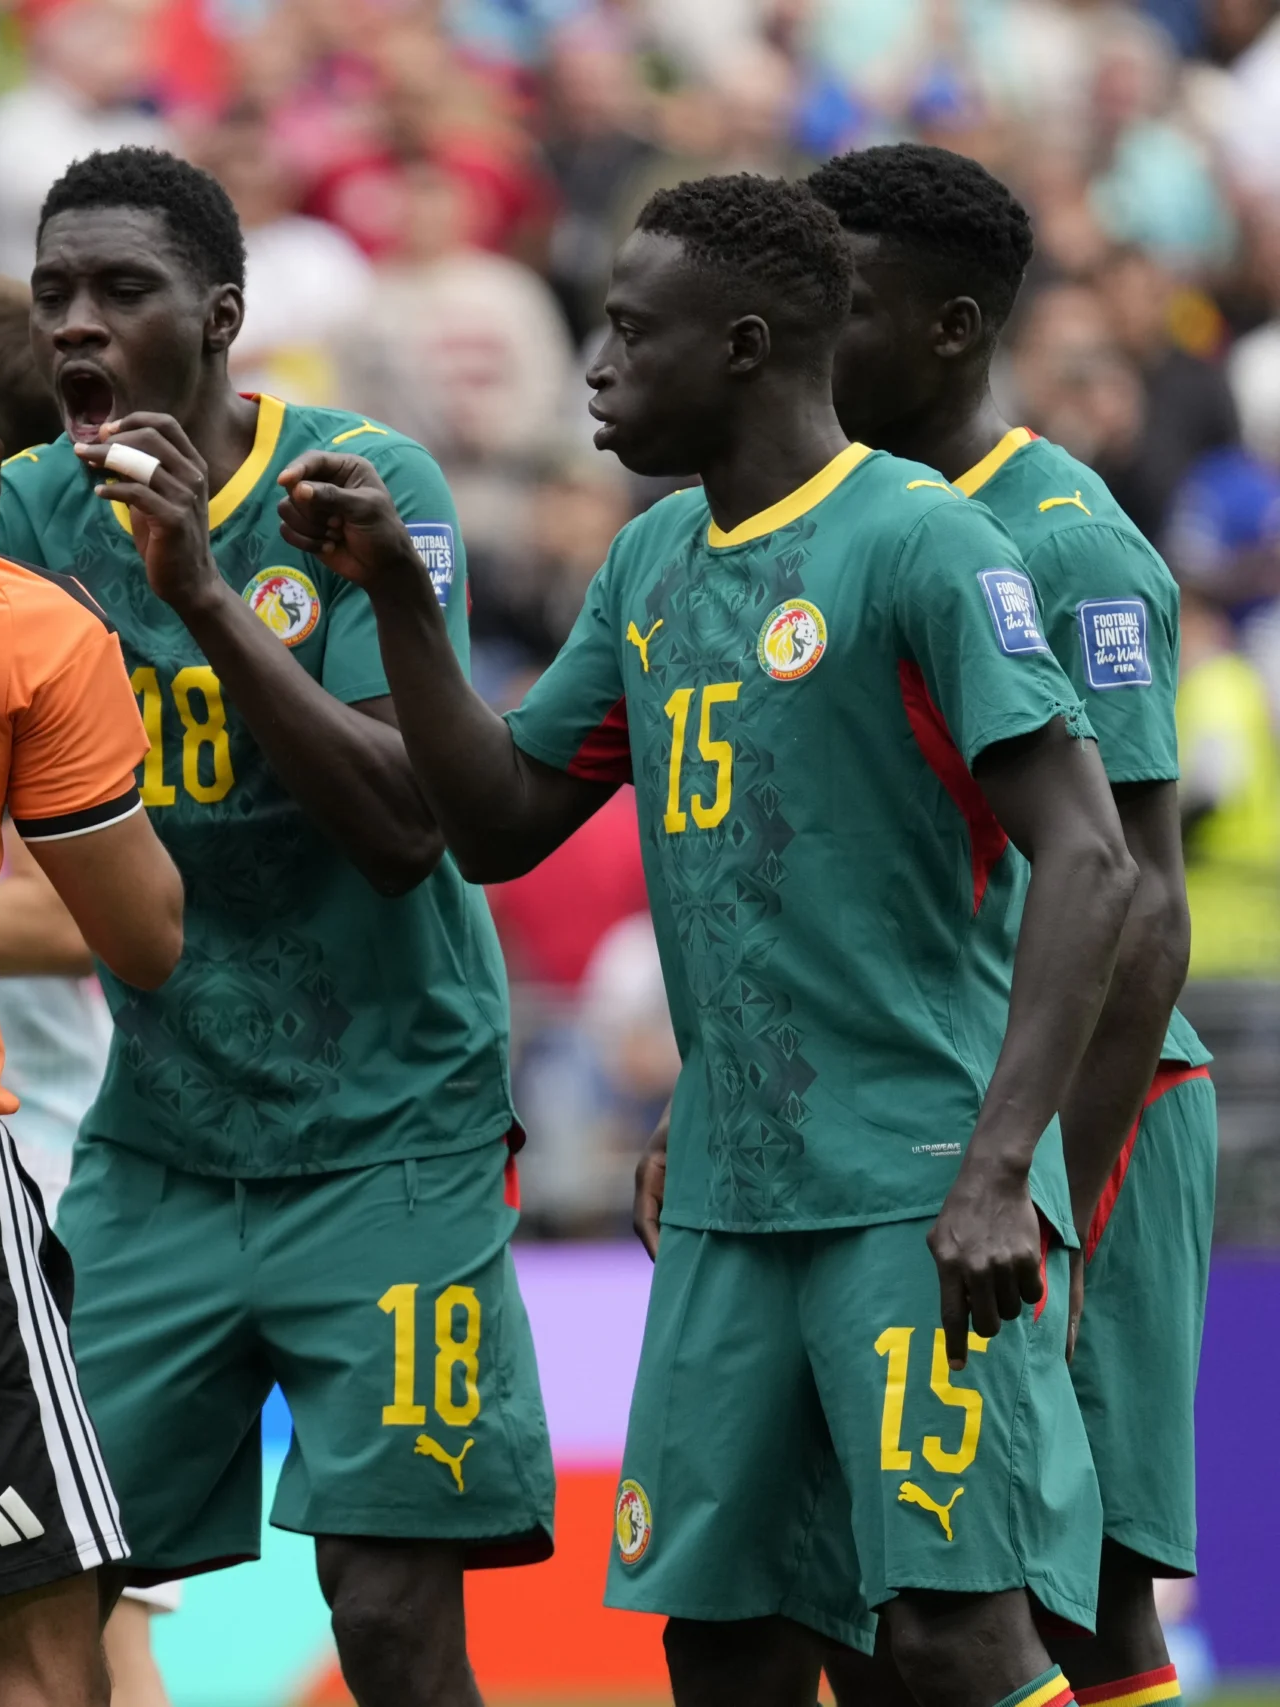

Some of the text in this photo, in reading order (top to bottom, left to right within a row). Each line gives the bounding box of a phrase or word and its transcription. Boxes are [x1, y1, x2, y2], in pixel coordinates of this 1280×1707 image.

[410, 535, 450, 549] OOTBALL
[418, 549, 452, 568] NITES
[1093, 612, 1140, 629] FOOTBALL
[1095, 626, 1140, 648] UNITES
[1094, 647, 1116, 665] the
[1113, 663, 1134, 674] FIFA
[130, 665, 235, 807] 18
[664, 682, 741, 834] 15
[377, 1284, 481, 1427] 18
[874, 1326, 991, 1474] 15
